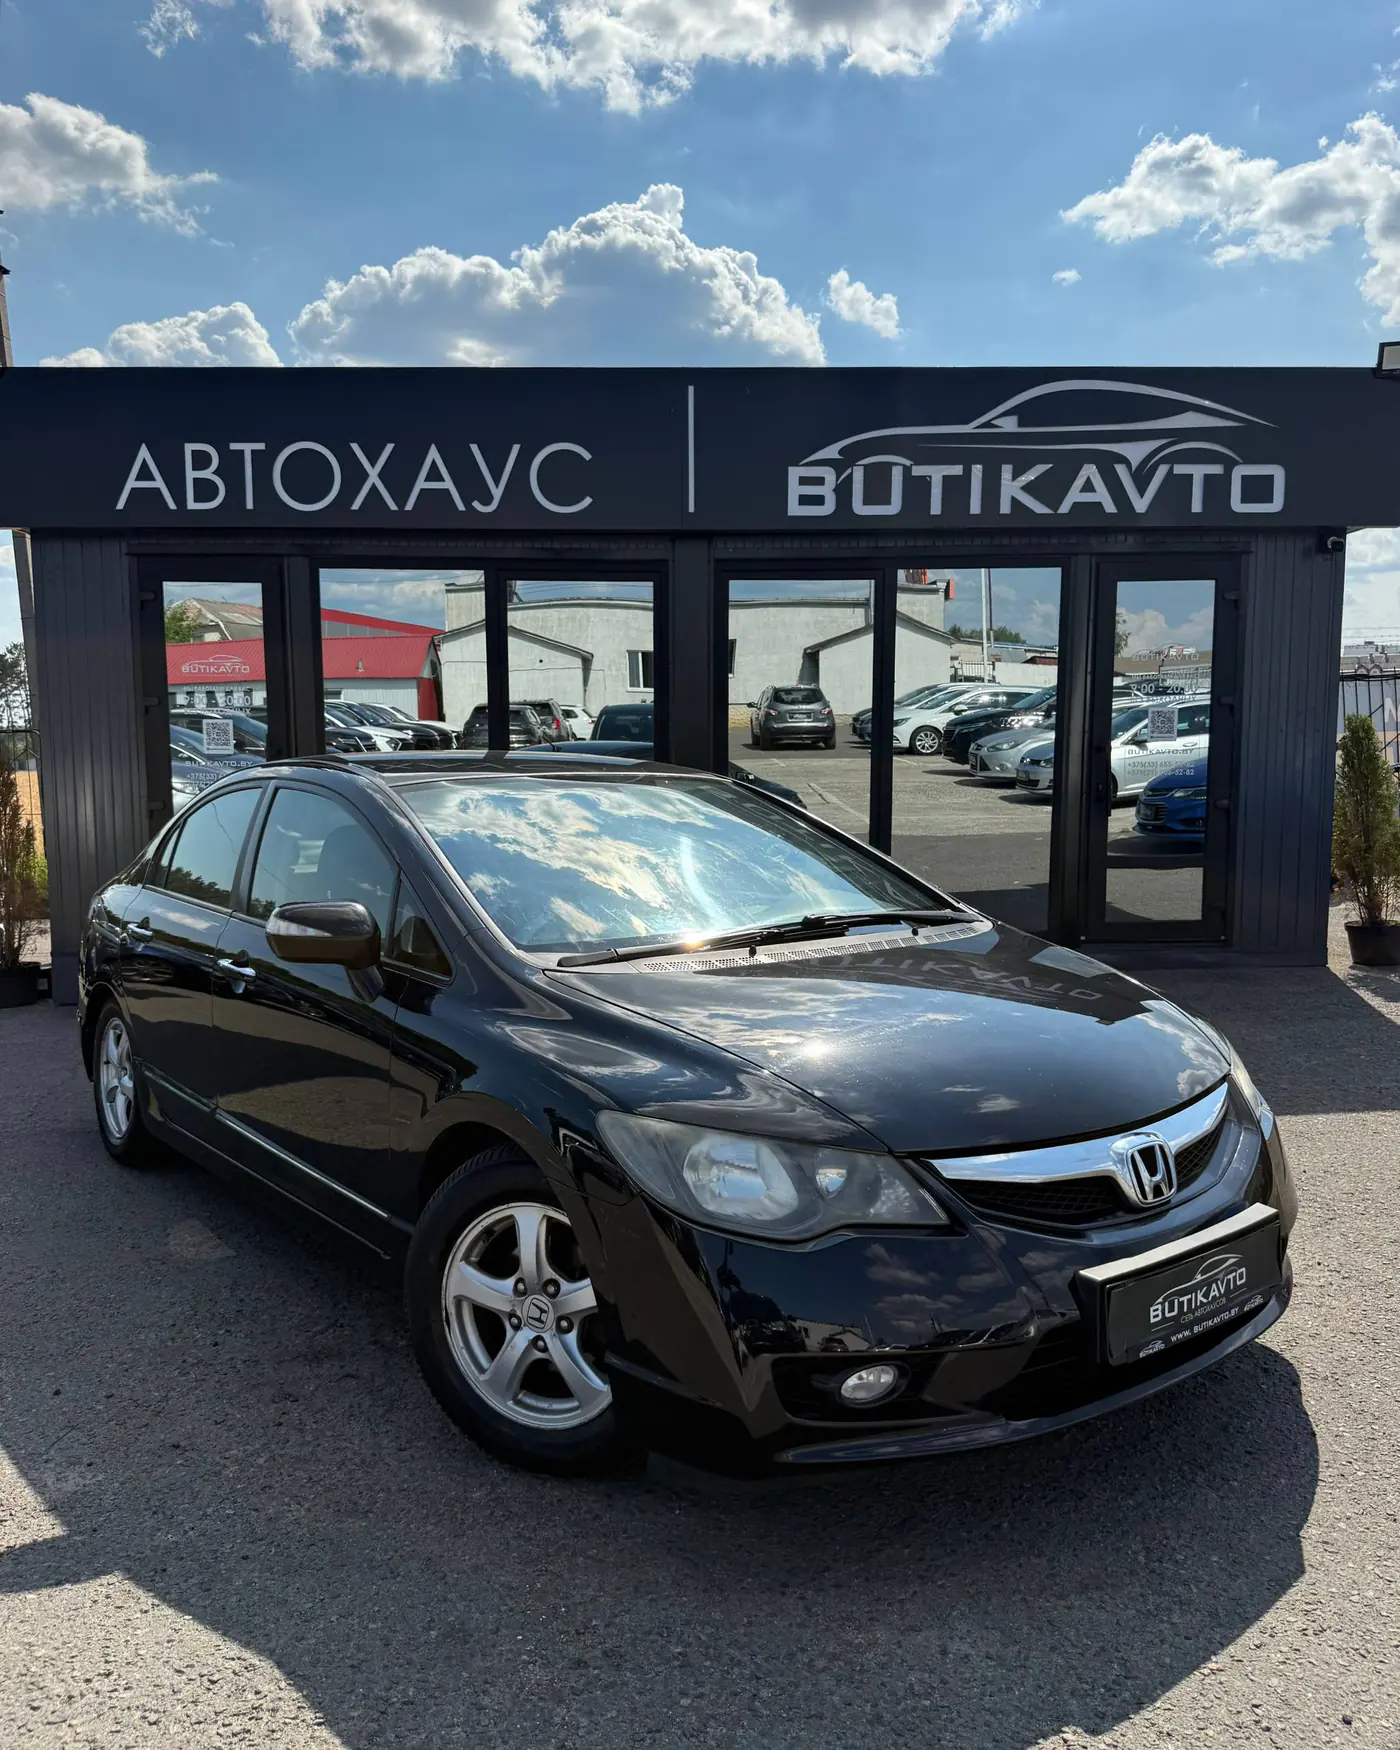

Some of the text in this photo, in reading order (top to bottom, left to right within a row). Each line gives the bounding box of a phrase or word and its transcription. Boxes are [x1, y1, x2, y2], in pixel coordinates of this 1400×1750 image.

[115, 440, 594, 514] АВТОХАУС
[787, 462, 1286, 516] BUTIKAVTO
[181, 664, 250, 673] BUTIKAVTO
[1150, 1267, 1246, 1324] BUTIKAVTO
[1193, 1307, 1239, 1333] BUTIKAVTO.BY
